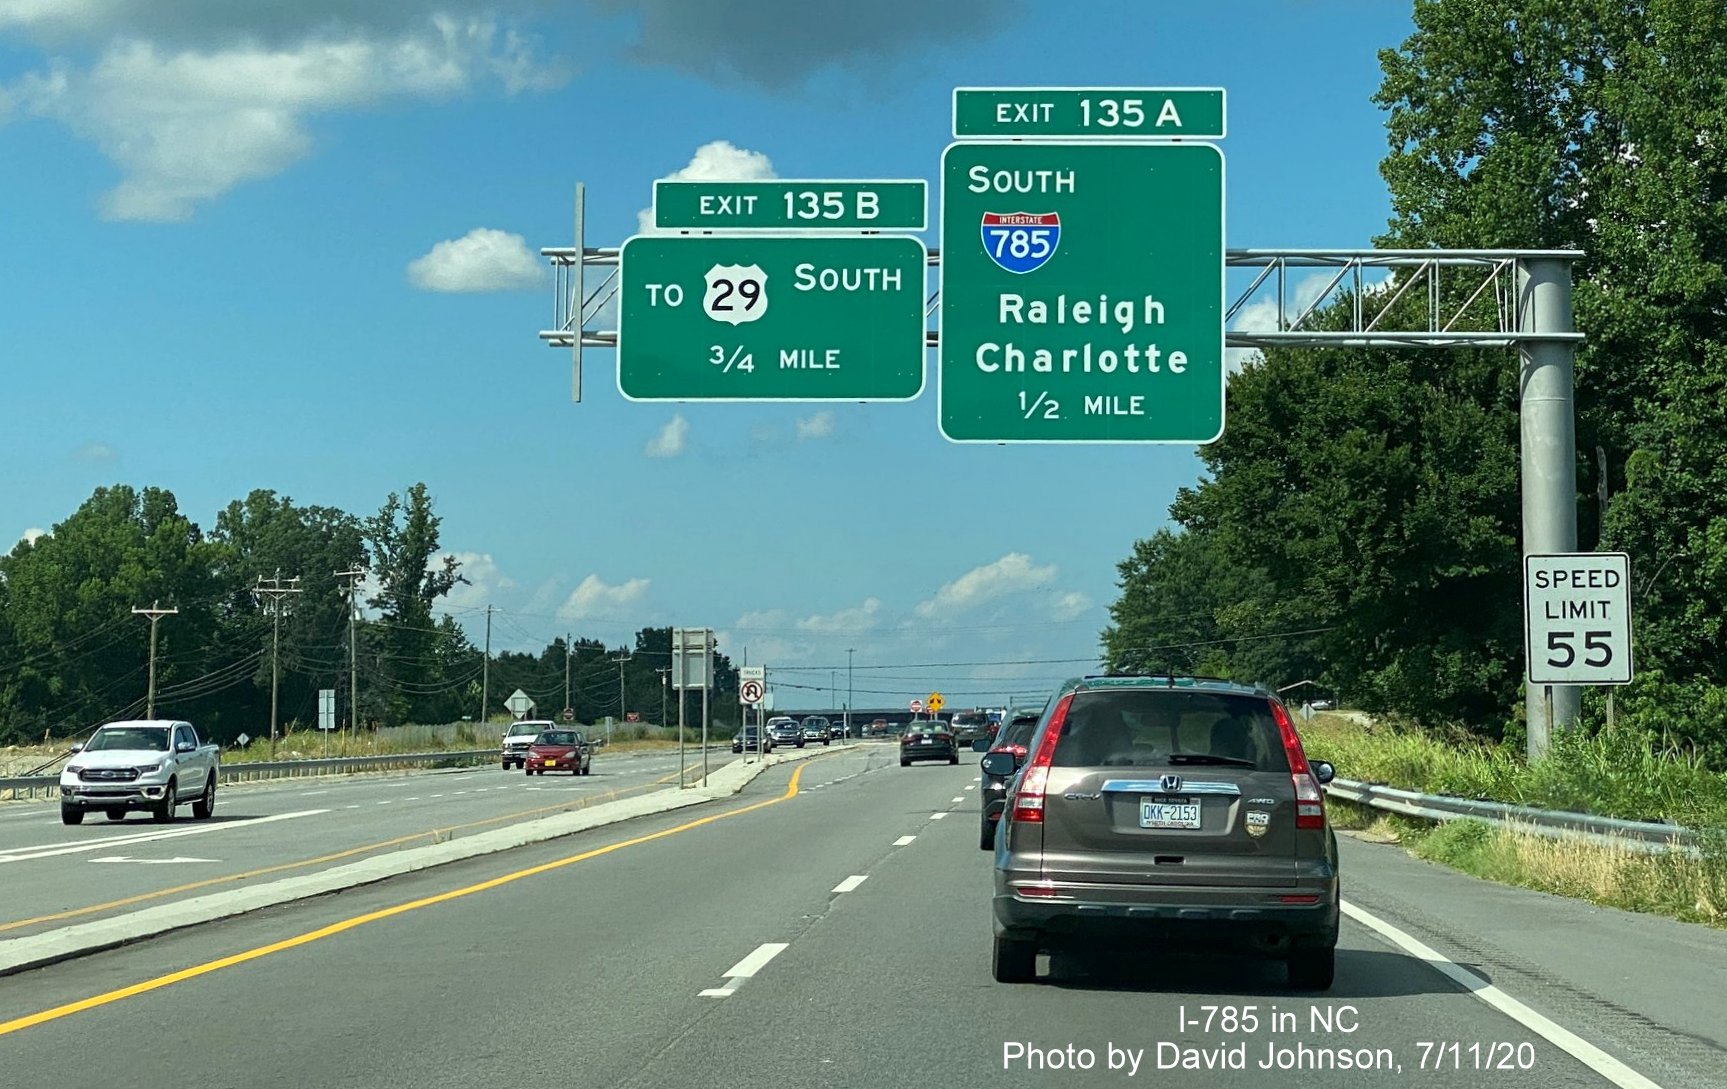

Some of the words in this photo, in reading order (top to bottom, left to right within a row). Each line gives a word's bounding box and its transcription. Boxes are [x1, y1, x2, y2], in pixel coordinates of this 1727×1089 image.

[996, 103, 1054, 123] EXIT
[1080, 99, 1145, 127] 135
[1155, 99, 1183, 127] A
[968, 165, 1075, 193] SOUTH
[700, 195, 758, 215] EXIT
[783, 191, 845, 220] 135
[856, 191, 880, 220] B
[999, 216, 1043, 225] INTERSTATE
[990, 230, 1050, 258] 785
[793, 263, 901, 291] SOUTH
[645, 284, 684, 307] TO
[711, 278, 760, 312] 29
[999, 293, 1165, 334] Raleigh
[709, 345, 755, 373] 3/4
[779, 349, 840, 369] MILE
[976, 342, 1188, 374] Charlotte
[1018, 391, 1059, 420] 1/2
[1084, 395, 1145, 415] MILE
[1535, 569, 1620, 589] SPEED
[1545, 600, 1611, 620] LIMIT
[1547, 630, 1613, 668] 55
[1143, 804, 1197, 821] DKK-2153
